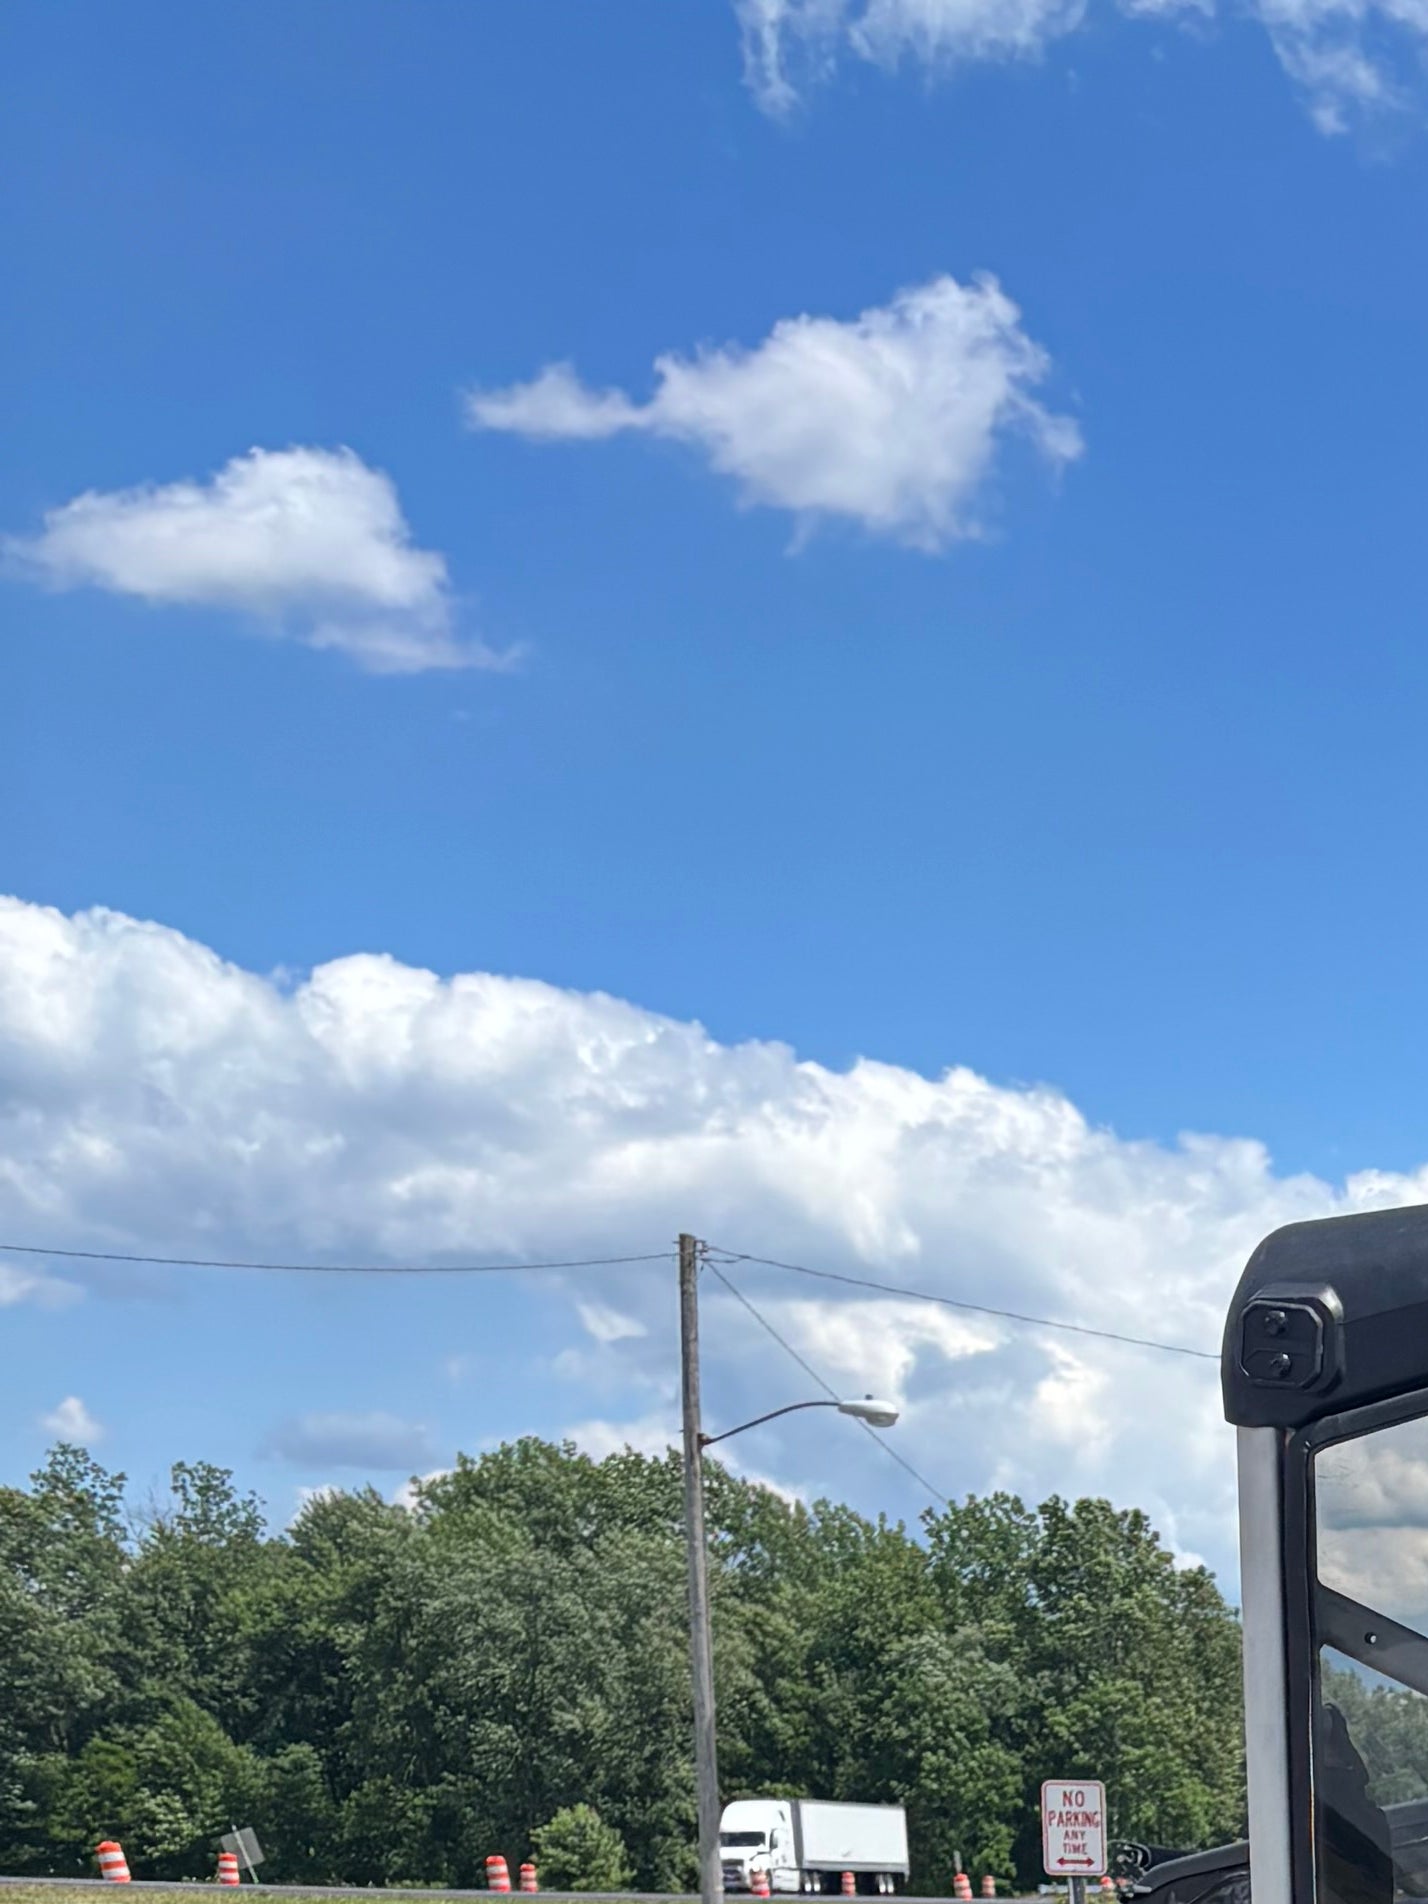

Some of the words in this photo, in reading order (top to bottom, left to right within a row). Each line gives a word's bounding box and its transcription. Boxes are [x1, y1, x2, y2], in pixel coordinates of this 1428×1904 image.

[1062, 1790, 1085, 1808] NO
[1048, 1810, 1101, 1828] PARKING
[1063, 1830, 1086, 1841] ANY
[1063, 1843, 1088, 1855] TIME
